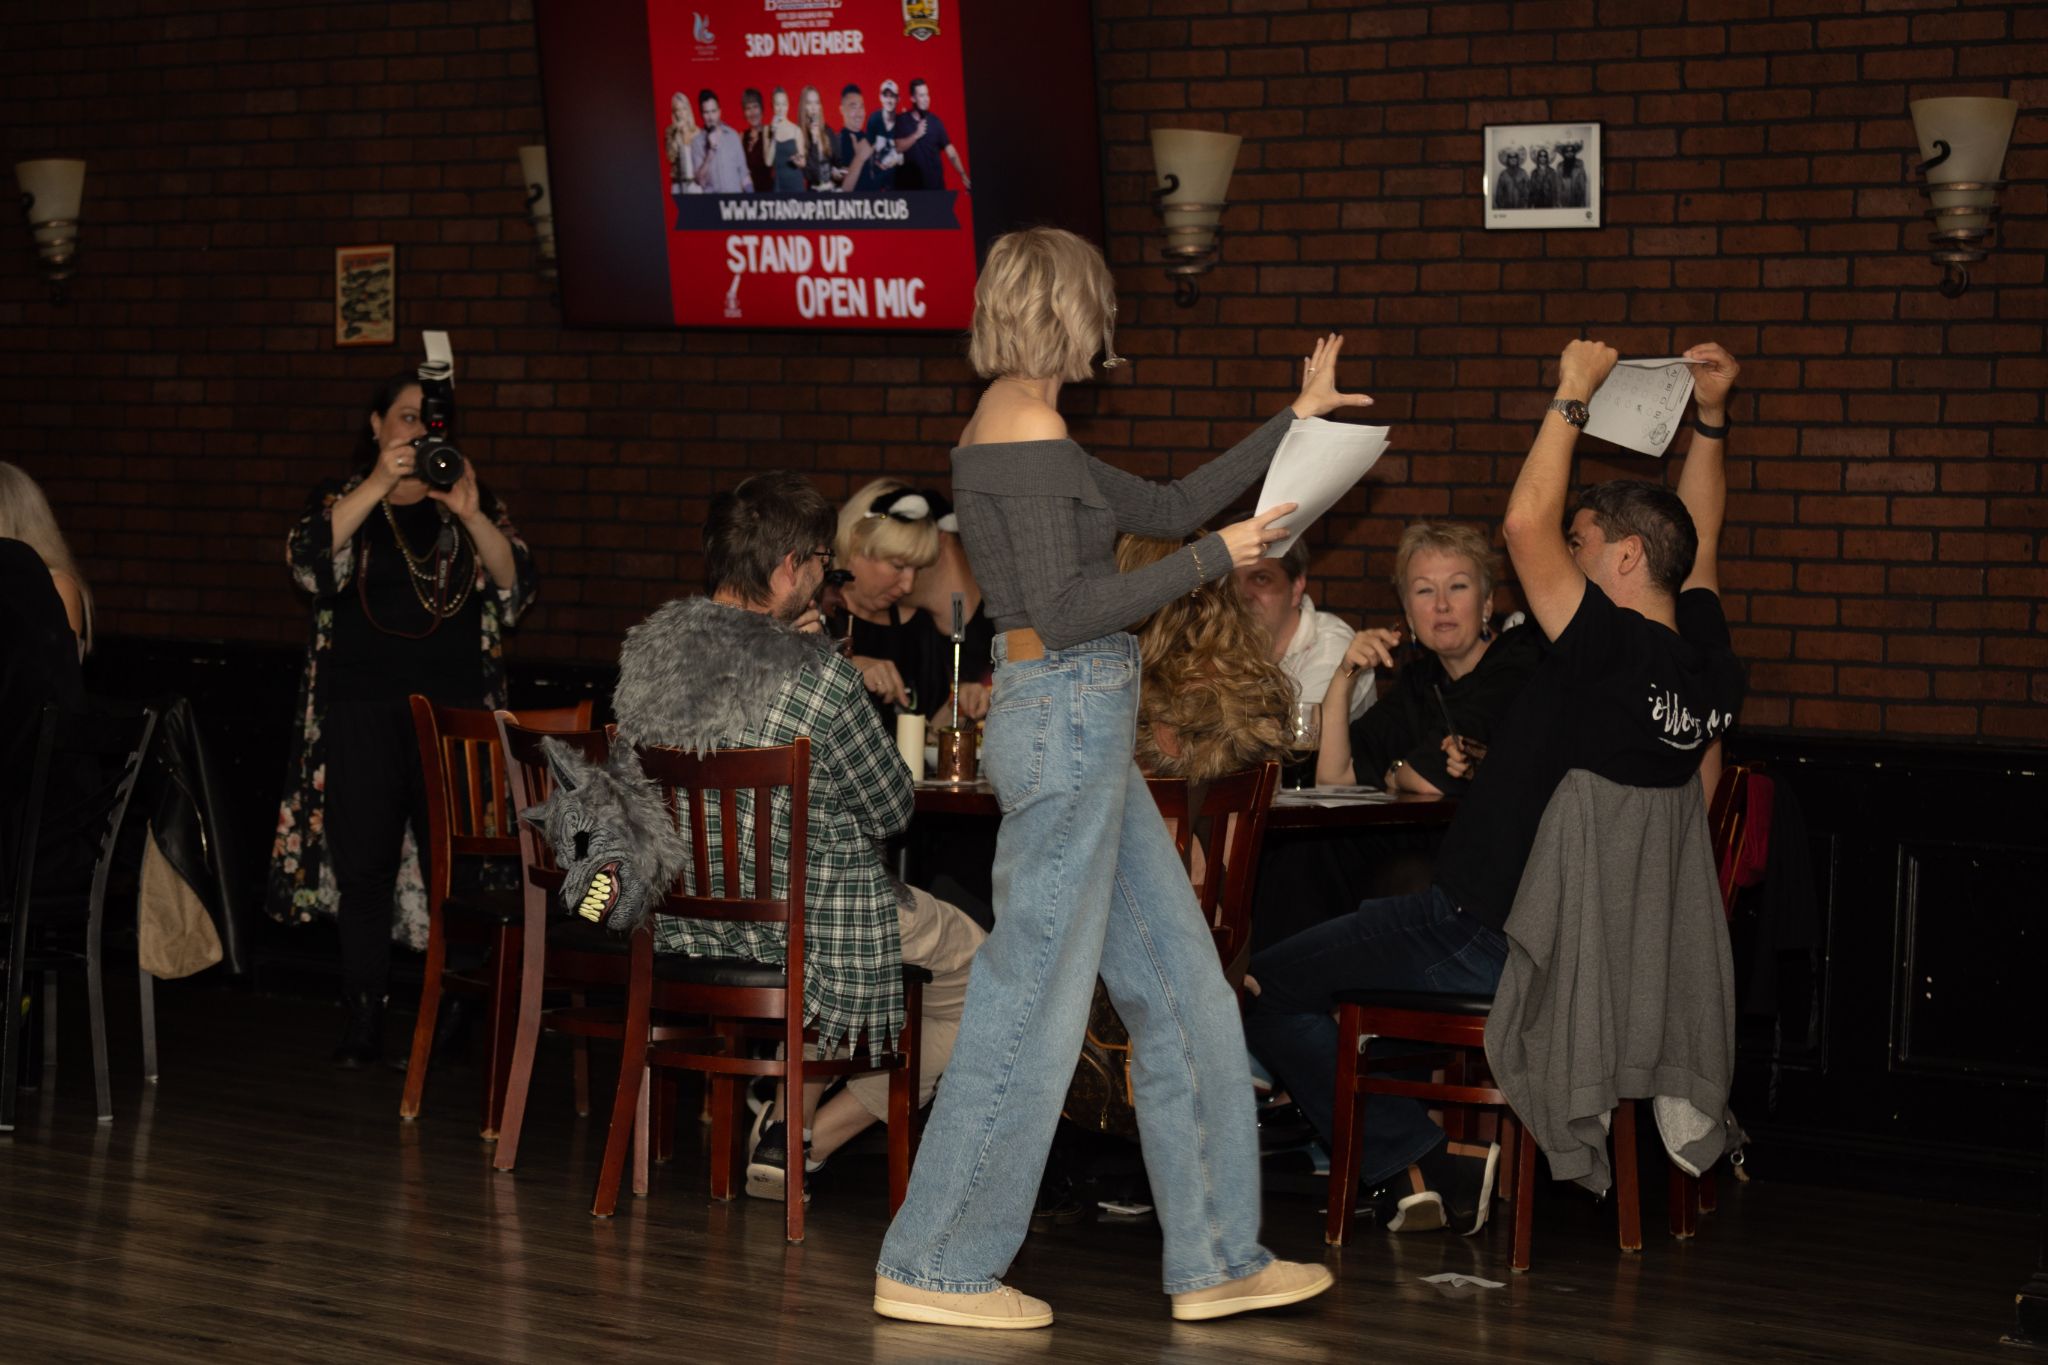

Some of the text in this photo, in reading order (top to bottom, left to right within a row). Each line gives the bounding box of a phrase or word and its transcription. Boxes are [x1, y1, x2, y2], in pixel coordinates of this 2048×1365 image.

[745, 29, 865, 58] 3RD NOVEMBER
[719, 198, 909, 221] WWW.STANDUPATLANTA.CLUB
[726, 234, 854, 274] STAND UP
[796, 275, 926, 319] OPEN MIC
